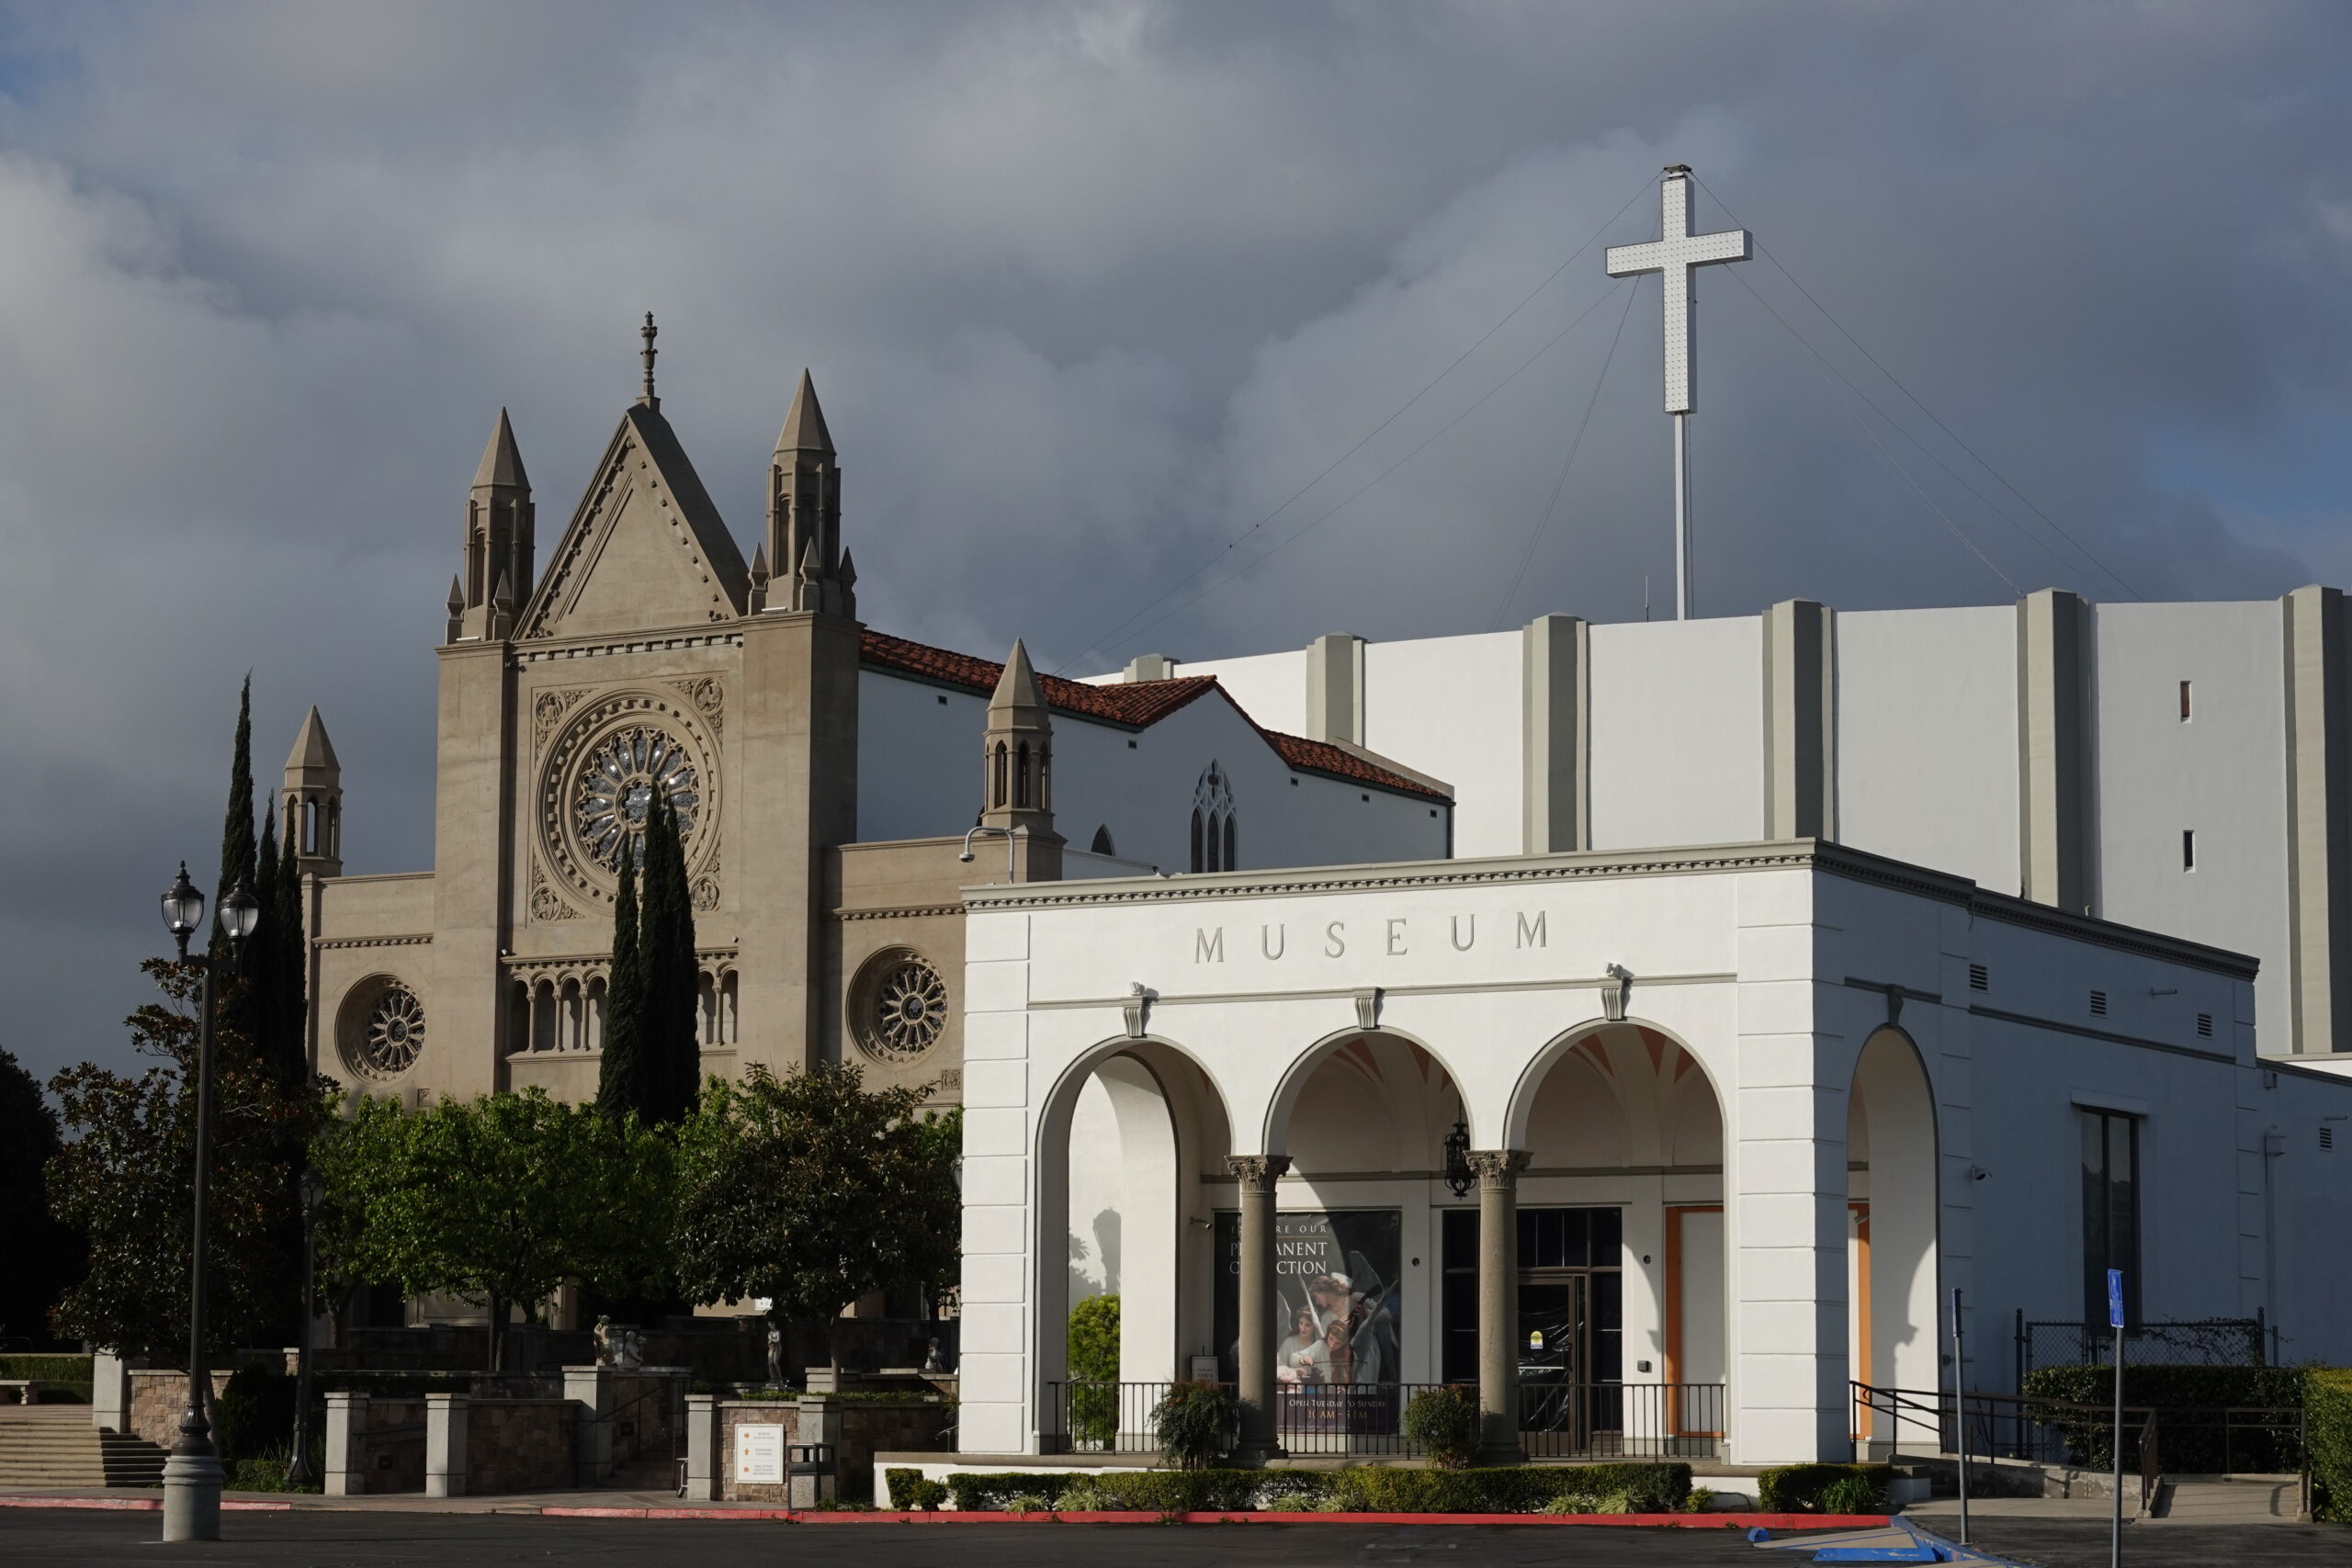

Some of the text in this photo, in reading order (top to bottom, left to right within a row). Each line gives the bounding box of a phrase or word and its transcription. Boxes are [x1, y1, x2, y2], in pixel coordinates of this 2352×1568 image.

[1194, 910, 1547, 964] MUSEUM
[1299, 1224, 1327, 1234] OUR
[1229, 1260, 1327, 1275] CCTION
